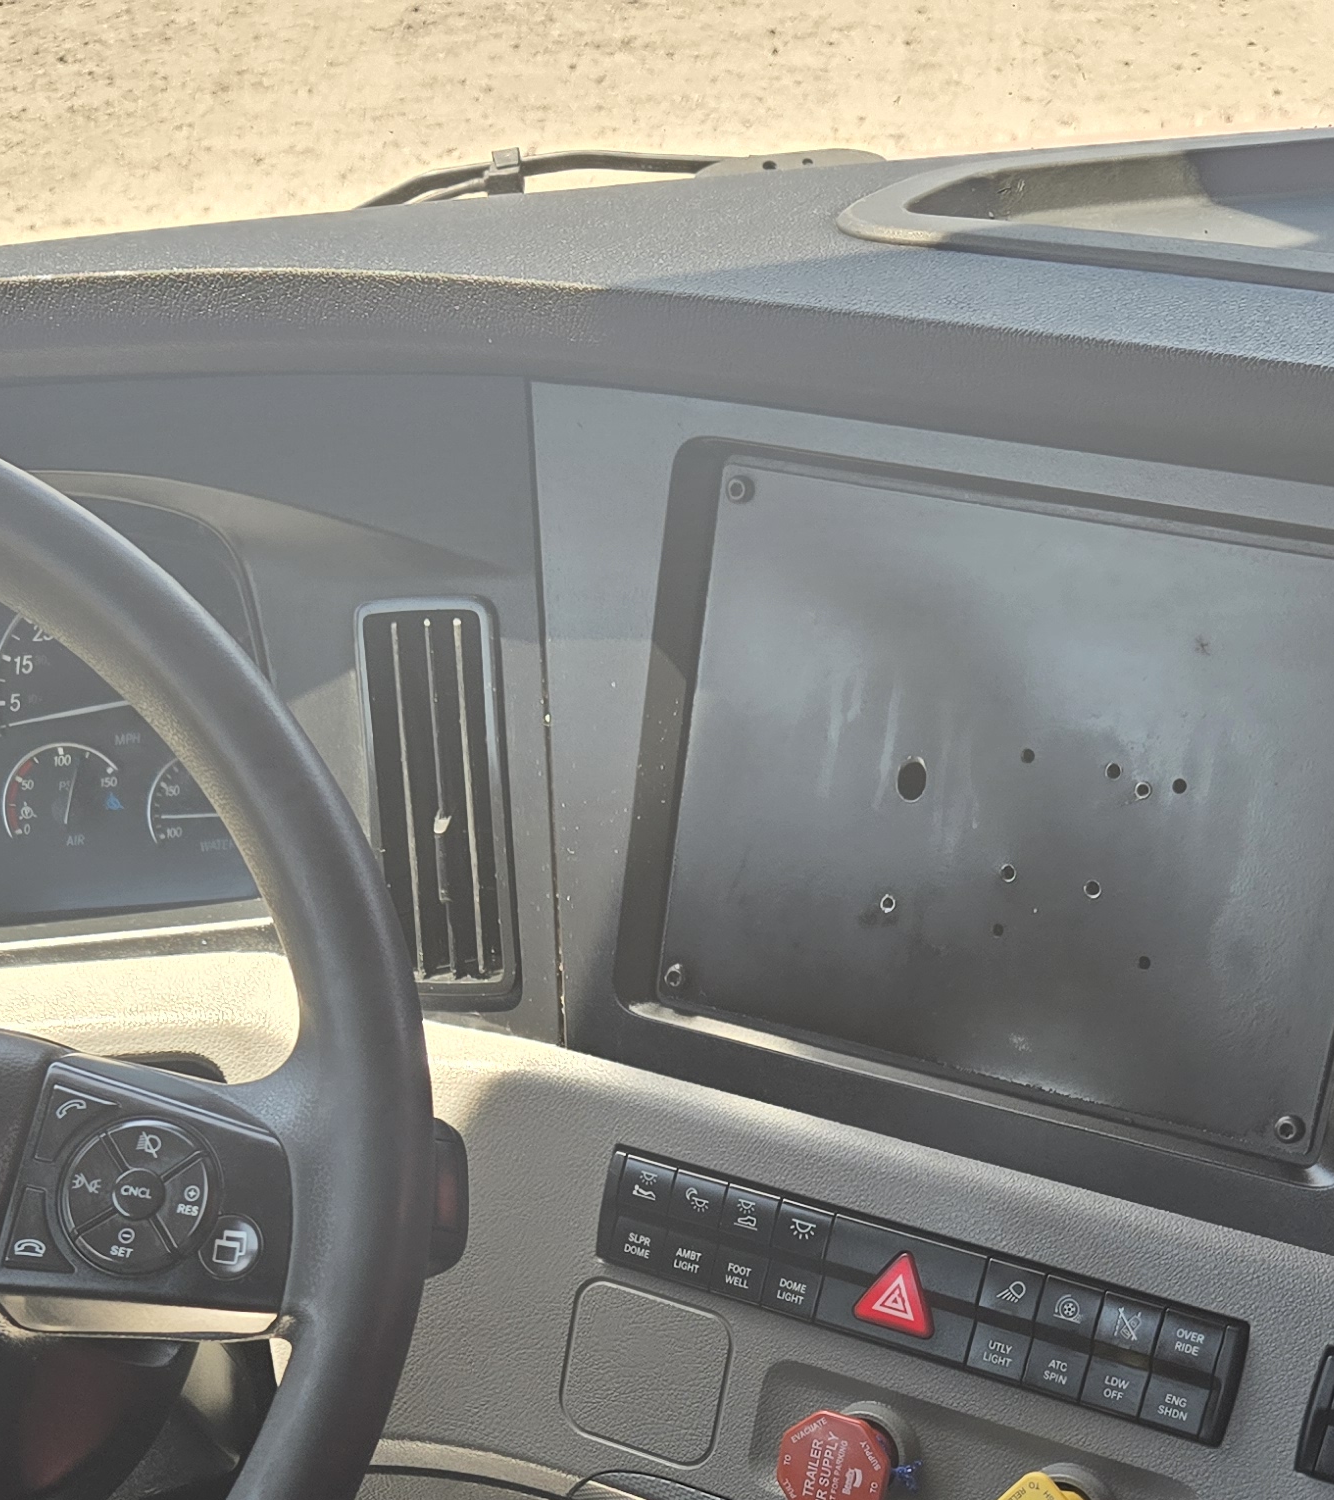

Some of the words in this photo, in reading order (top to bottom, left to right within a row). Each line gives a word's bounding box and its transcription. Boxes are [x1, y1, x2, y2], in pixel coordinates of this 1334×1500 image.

[14, 655, 33, 675] 15
[9, 694, 21, 712] 5
[115, 733, 141, 746] MPH
[54, 754, 71, 767] 100
[21, 779, 34, 790] 50
[100, 777, 117, 788] 150
[165, 784, 180, 797] 150
[24, 824, 31, 835] 0
[167, 826, 182, 839] 100
[67, 835, 85, 846] AIR
[121, 1184, 152, 1199] CNCL
[176, 1202, 199, 1217] RES
[628, 1232, 651, 1247] SLPR
[110, 1245, 134, 1258] SET
[624, 1243, 650, 1260] DOME
[676, 1248, 702, 1262] AMBT
[673, 1259, 700, 1274] LIGHT
[727, 1262, 752, 1277] FOOT
[725, 1274, 749, 1289] WELL
[779, 1278, 807, 1294] DOME
[776, 1289, 804, 1305] LIGHT
[1176, 1328, 1205, 1344] OVER
[988, 1339, 1013, 1355] UTLY
[1174, 1341, 1200, 1357] RIDE
[982, 1351, 1013, 1368] LIGHT
[1048, 1359, 1068, 1372] ATC
[1043, 1370, 1067, 1386] SPIN
[1104, 1375, 1130, 1390] LDW
[1103, 1387, 1124, 1401] OFF
[1164, 1393, 1187, 1408] ENG
[1157, 1404, 1188, 1422] SHDN
[790, 1417, 828, 1443] EVACUATE
[783, 1454, 792, 1466] TO
[819, 1431, 839, 1487] SUPPLY
[835, 1440, 848, 1476] PARKING
[859, 1440, 882, 1471] SUPPLY
[802, 1439, 824, 1496] TRAILER
[783, 1478, 797, 1499] PULL
[831, 1475, 840, 1495] FOR
[869, 1481, 878, 1493] TO
[1028, 1481, 1040, 1490] TO
